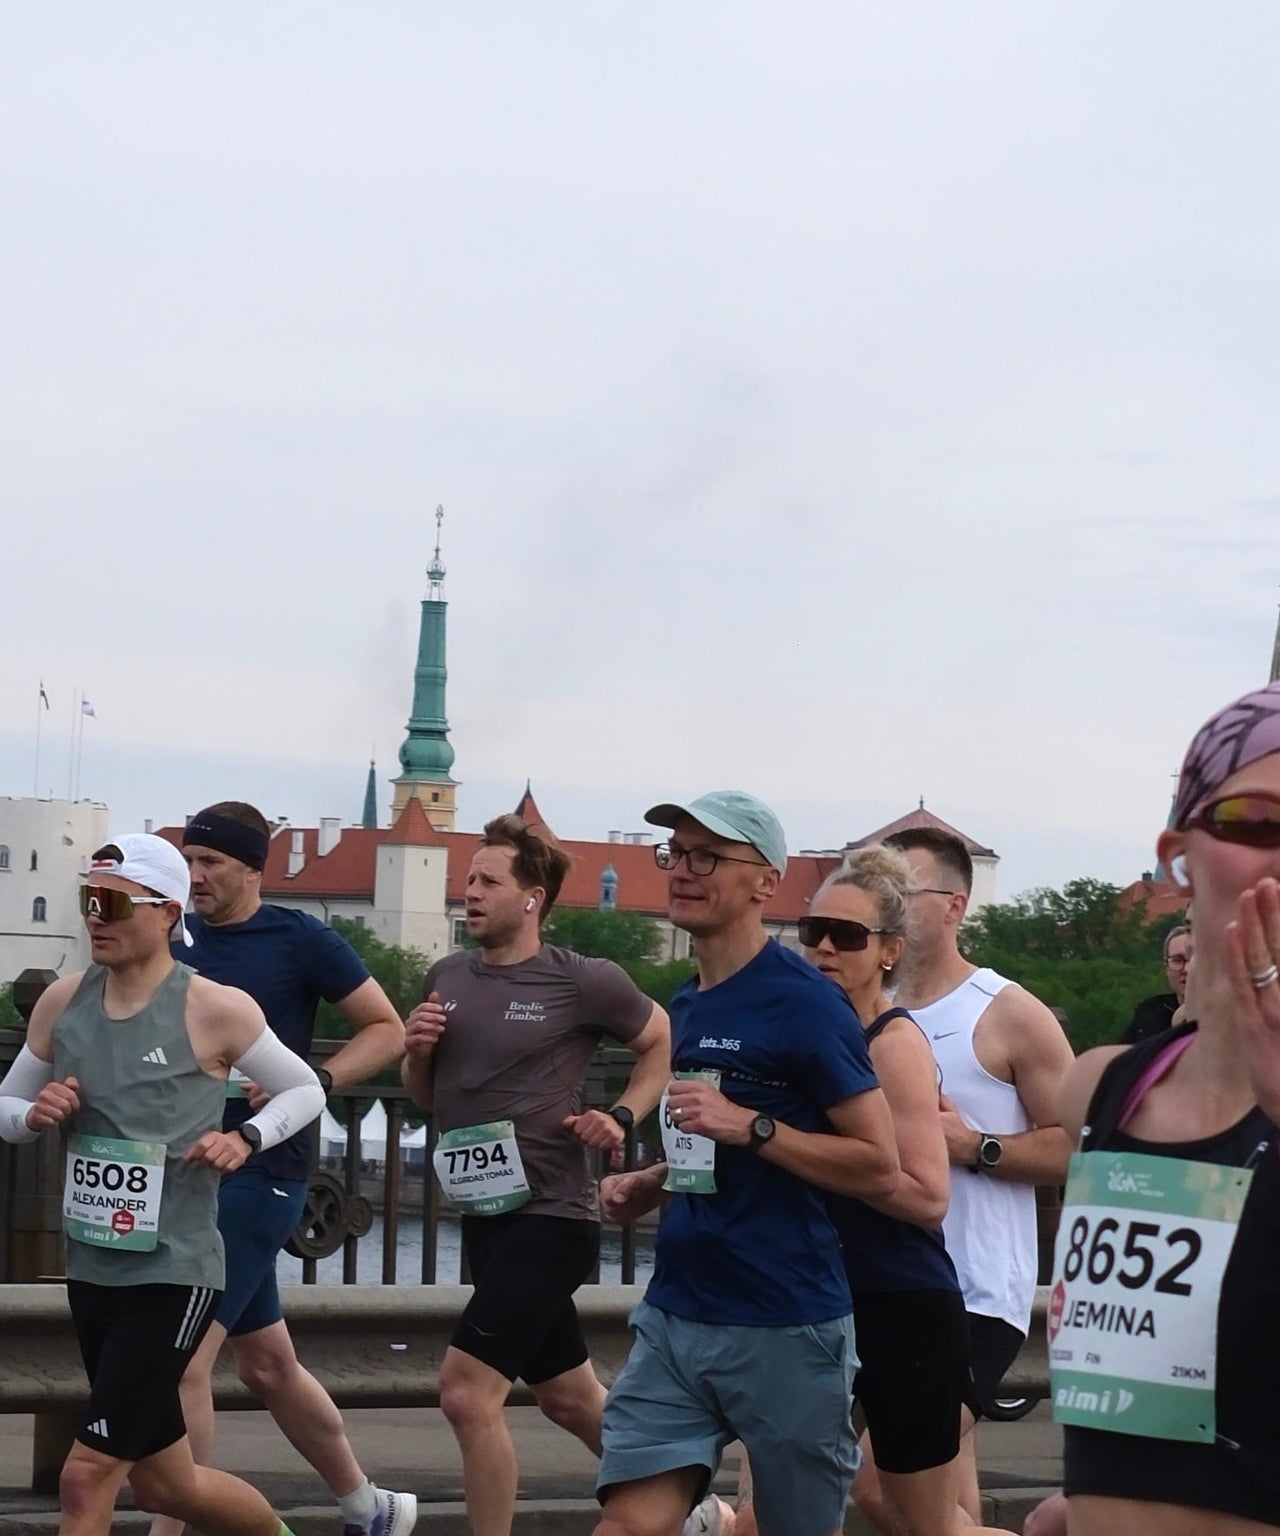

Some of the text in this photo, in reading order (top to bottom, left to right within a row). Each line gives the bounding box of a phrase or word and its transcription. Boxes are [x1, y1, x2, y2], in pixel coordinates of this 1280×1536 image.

[504, 1010, 547, 1022] Timber
[675, 1137, 693, 1150] ATIS
[443, 1143, 508, 1174] 7794
[74, 1158, 148, 1193] 6508
[73, 1191, 147, 1212] ALEXANDER
[1064, 1215, 1202, 1297] 8652
[1064, 1300, 1156, 1339] JEMINA
[1085, 1352, 1101, 1365] FIN
[1171, 1365, 1207, 1380] 21KM
